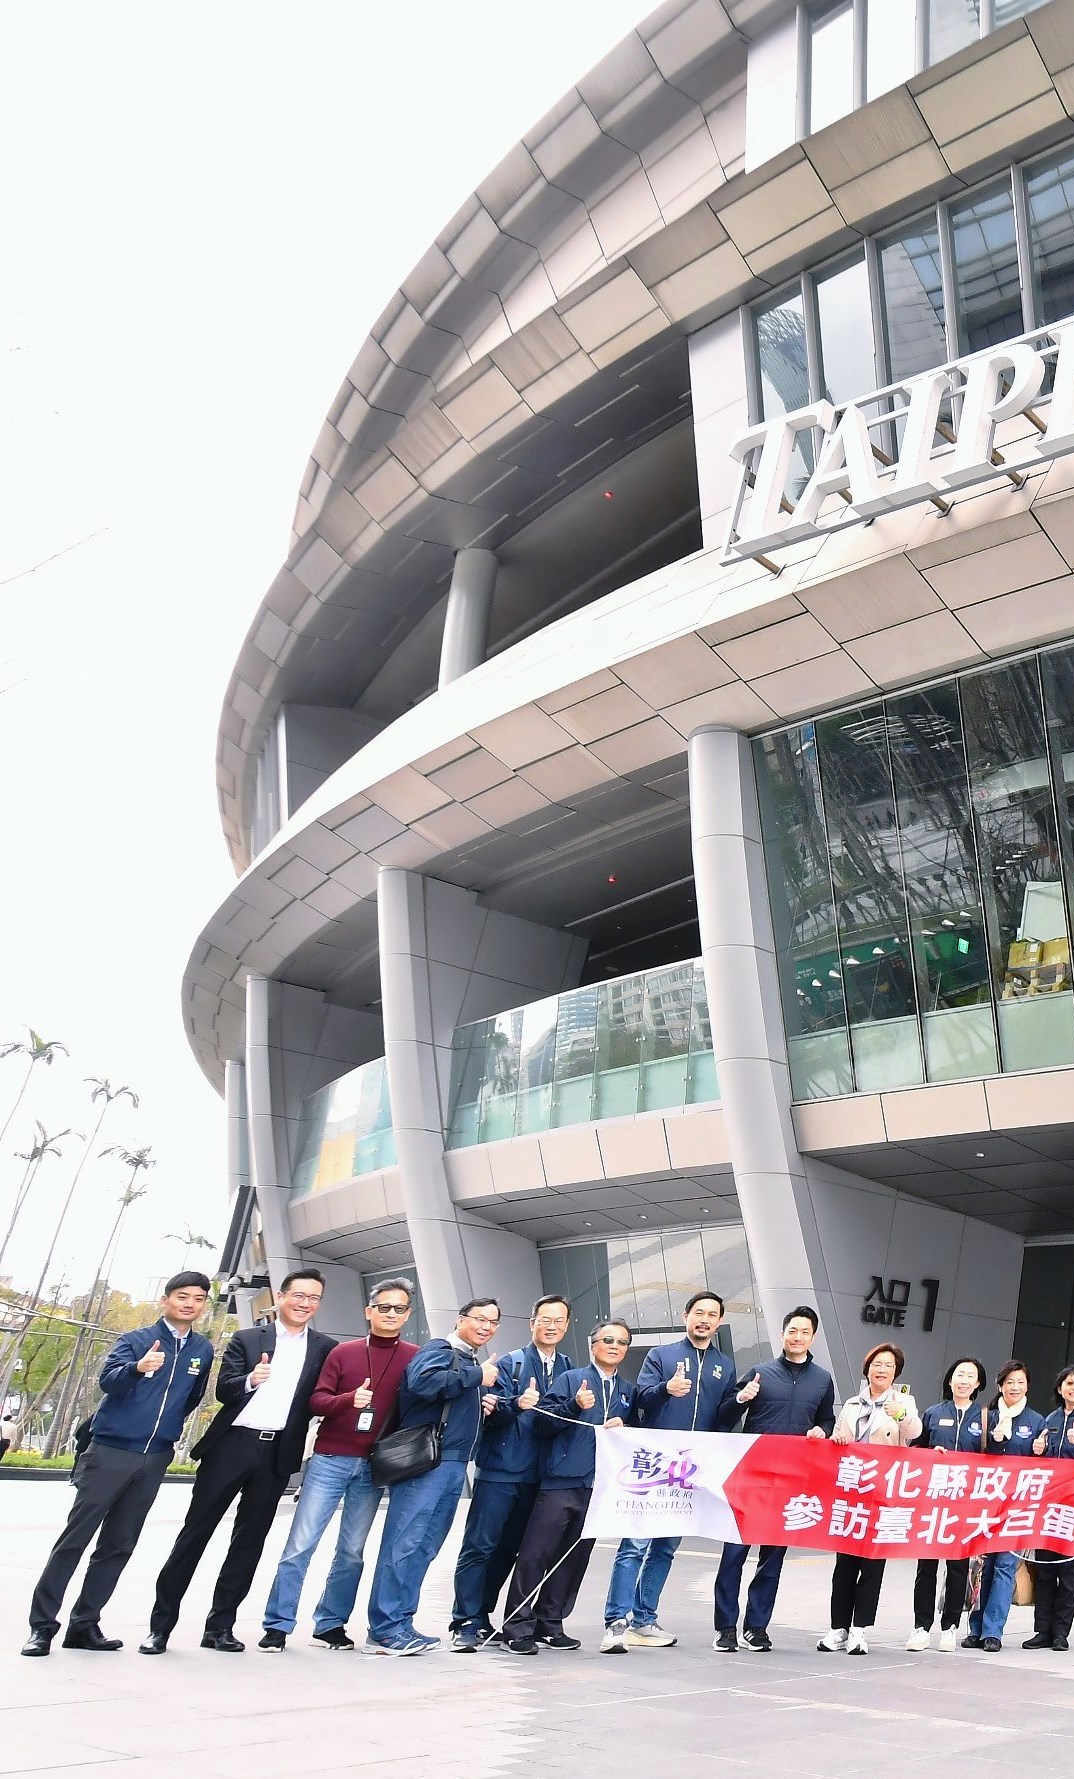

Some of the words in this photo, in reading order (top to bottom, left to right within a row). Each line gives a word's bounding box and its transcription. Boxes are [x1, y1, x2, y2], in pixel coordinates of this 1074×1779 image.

[861, 1304, 907, 1328] GATE
[863, 1275, 911, 1307] 入口
[921, 1278, 940, 1332] 1
[630, 1447, 698, 1490] 彰化
[835, 1456, 1054, 1501] 彰化縣政府
[616, 1499, 693, 1510] CHANGHUA
